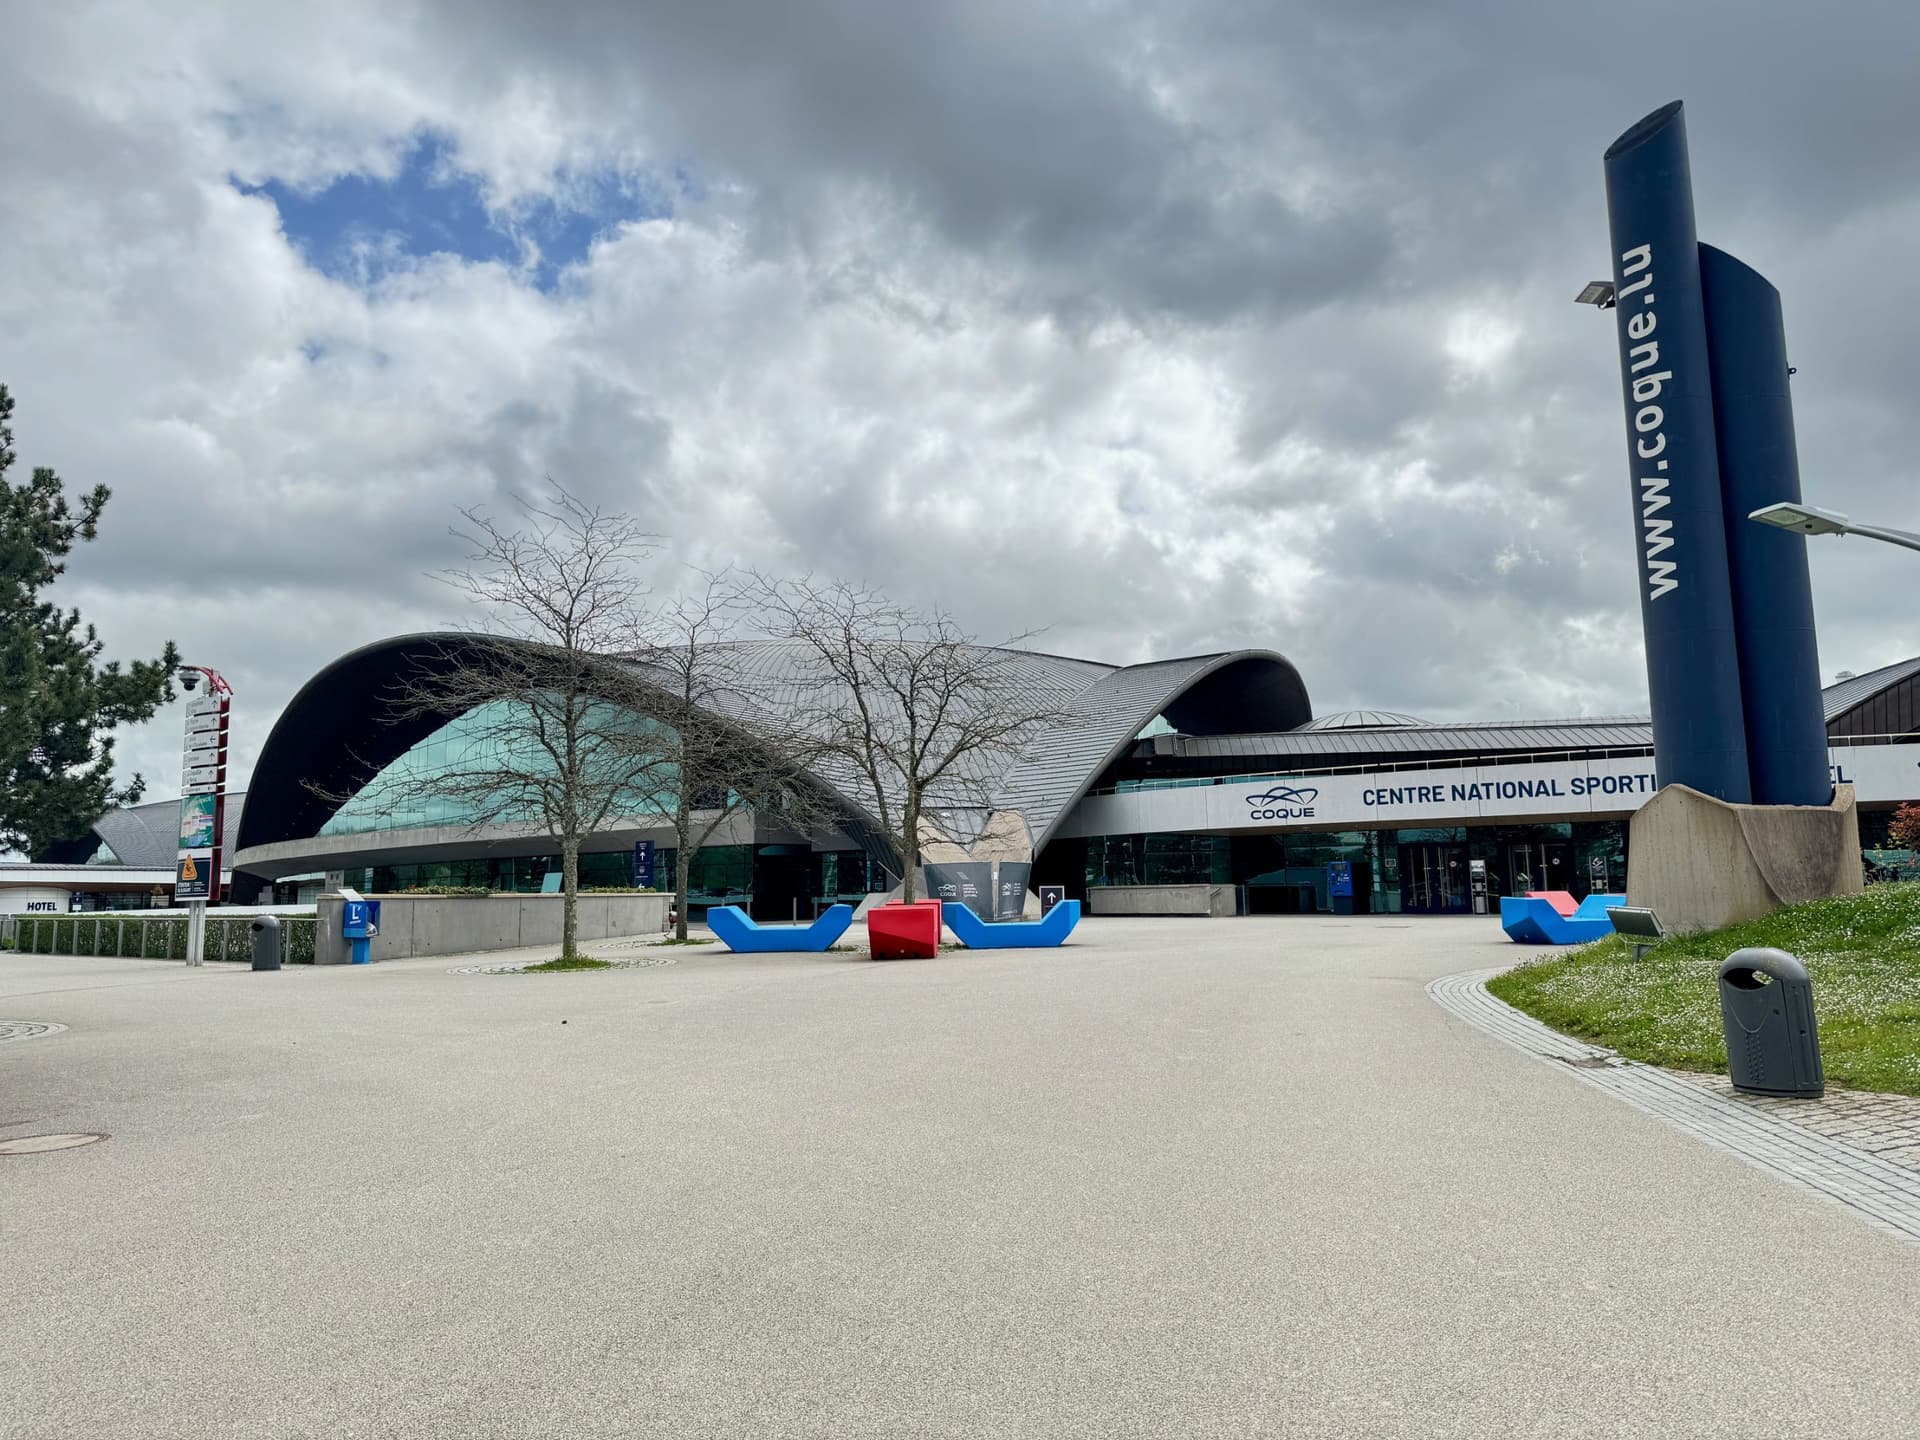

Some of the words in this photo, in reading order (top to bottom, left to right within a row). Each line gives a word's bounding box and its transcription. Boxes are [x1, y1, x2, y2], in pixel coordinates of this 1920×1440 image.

[1618, 243, 1679, 601] www.coque.lu
[1362, 785, 1446, 806] CENTRE
[1451, 779, 1566, 801] NATIONAL
[1570, 774, 1657, 795] SPORTI
[1250, 807, 1315, 820] COQUE
[27, 901, 57, 911] HOTEL
